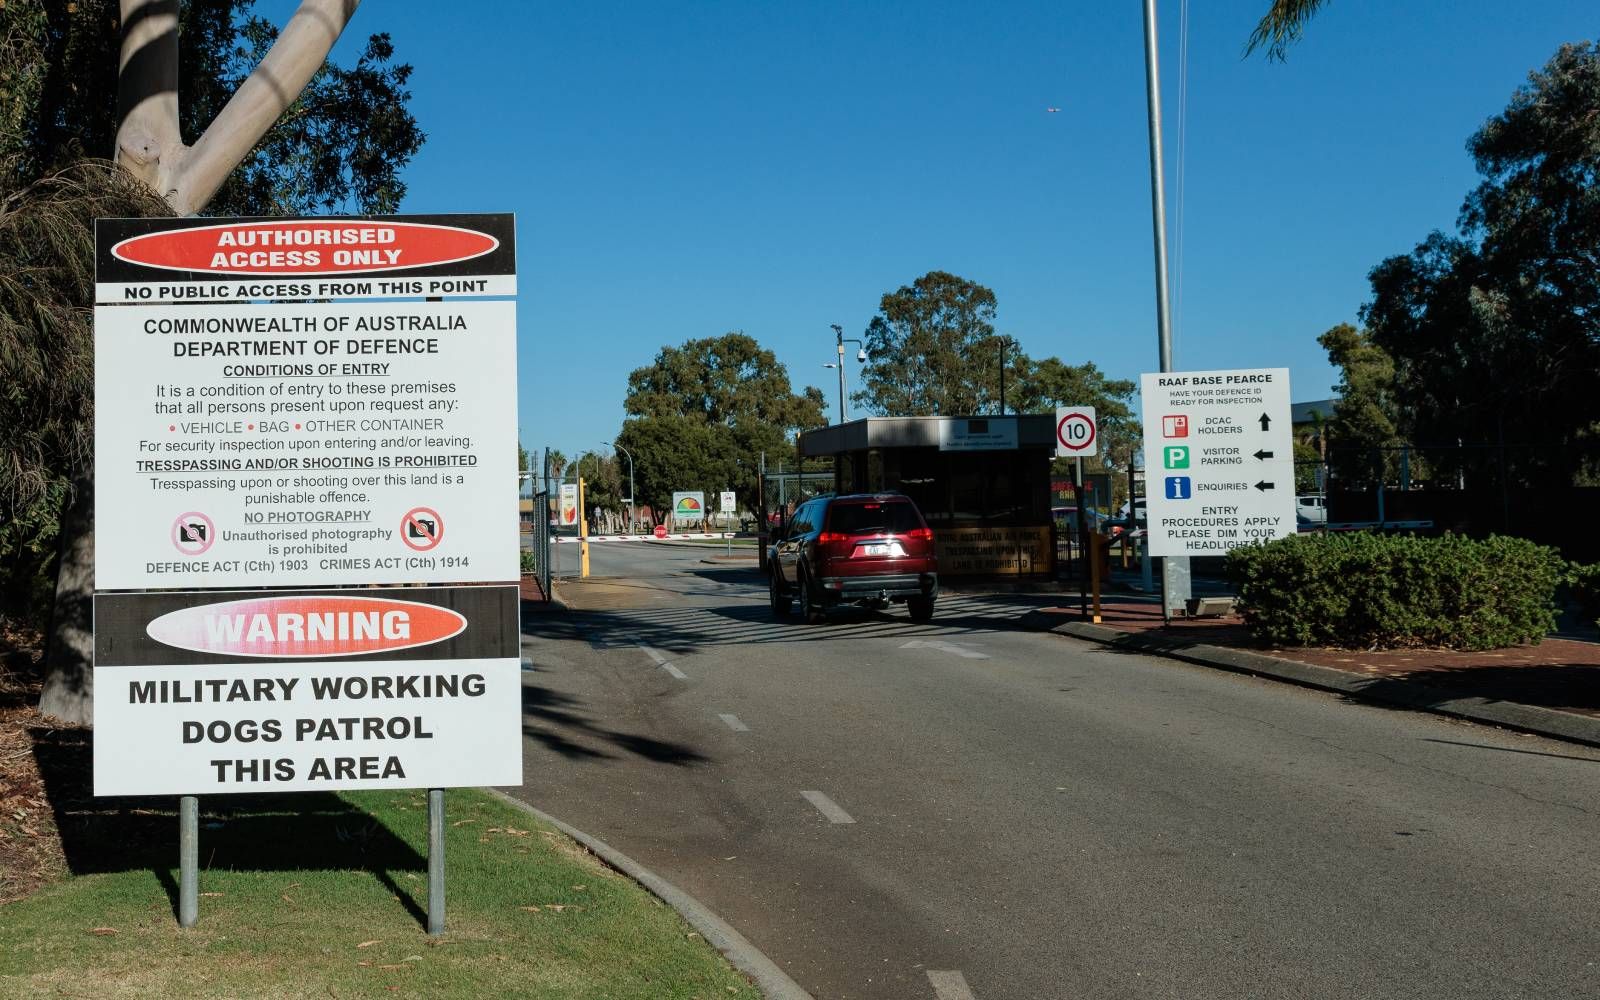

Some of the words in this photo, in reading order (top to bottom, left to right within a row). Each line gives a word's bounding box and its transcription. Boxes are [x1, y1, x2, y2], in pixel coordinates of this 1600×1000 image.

[218, 229, 395, 246] AUTHORISED
[211, 251, 320, 267] ACCESS
[334, 250, 401, 265] ONLY
[125, 287, 152, 299] NO
[160, 286, 229, 298] PUBLIC
[236, 284, 311, 297] ACCESS
[319, 283, 371, 295] FROM
[378, 282, 422, 294] THIS
[430, 280, 487, 293] POINT
[144, 317, 316, 334] COMMONWEALTH
[324, 317, 349, 331] OF
[355, 316, 467, 331] AUSTRALIA
[174, 341, 307, 356] DEPARTMENT
[314, 340, 339, 355] OF
[347, 339, 438, 354] DEFENCE
[224, 364, 313, 376] CONDITIONS
[318, 364, 337, 375] OF
[343, 363, 389, 374] ENTRY
[1159, 378, 1188, 386] RAAF
[1193, 377, 1222, 385] BASE
[1227, 375, 1272, 384] PEARCE
[157, 385, 165, 397] It
[171, 385, 181, 397] is
[187, 387, 194, 396] a
[200, 384, 264, 396] condition
[270, 383, 284, 395] of
[288, 384, 323, 398] entry
[329, 383, 341, 394] to
[347, 382, 385, 394] these
[392, 381, 456, 396] premises
[155, 402, 182, 414] that
[187, 401, 202, 413] all
[208, 403, 266, 416] persons
[271, 401, 324, 415] present
[329, 400, 365, 415] upon
[371, 398, 424, 413] request
[429, 400, 458, 412] any:
[181, 422, 242, 434] VEHICLE
[260, 421, 289, 432] BAG
[306, 420, 356, 432] OTHER
[361, 419, 443, 431] CONTAINER
[1067, 424, 1085, 439] 10
[1198, 426, 1242, 434] HOLDERS
[140, 441, 161, 451] For
[166, 440, 215, 453] security
[220, 439, 284, 453] inspection
[289, 440, 319, 451] upon
[325, 437, 376, 450] entering
[381, 436, 422, 447] and/or
[425, 435, 473, 449] leaving.
[136, 459, 241, 472] TRESSPASSING
[245, 458, 298, 470] AND/OR
[303, 457, 373, 469] SHOOTING
[379, 457, 390, 467] IS
[395, 455, 477, 467] PROHIBITED
[1169, 449, 1185, 467] P
[150, 477, 235, 491] Tresspassing
[241, 479, 271, 490] upon
[277, 479, 290, 487] or
[294, 475, 347, 489] shooting
[352, 477, 380, 486] over
[385, 474, 406, 485] this
[411, 473, 437, 485] land
[443, 473, 452, 484] is
[457, 476, 463, 484] a
[1198, 483, 1247, 491] ENQUIRIES
[246, 492, 315, 507] punishable
[320, 491, 370, 502] offence.
[245, 512, 264, 523] NO
[268, 510, 371, 523] PHOTOGRAPHY
[1202, 506, 1238, 515] ENTRY
[1162, 518, 1238, 526] PROCEDURES
[1245, 517, 1280, 526] APPLY
[223, 529, 307, 541] Unauthorised
[312, 528, 392, 542] photography
[1168, 530, 1211, 538] PLEASE
[1218, 529, 1237, 537] DIM
[1244, 529, 1275, 538] YOUR
[269, 544, 279, 554] is
[284, 543, 347, 557] prohibited
[147, 562, 209, 573] DEFENCE
[213, 561, 240, 572] ACT
[245, 561, 274, 574] (Cth)
[280, 560, 308, 570] 1903
[320, 559, 370, 569] CRIMES
[374, 558, 401, 568] ACT
[406, 557, 435, 570] (Cth)
[440, 557, 469, 567] 1914
[205, 610, 410, 641] WARNING
[130, 678, 299, 704] MILITARY
[311, 674, 485, 700] WORKING
[183, 720, 282, 744] DOGS
[296, 716, 433, 741] PATROL
[211, 759, 295, 782] THIS
[308, 756, 406, 780] AREA
